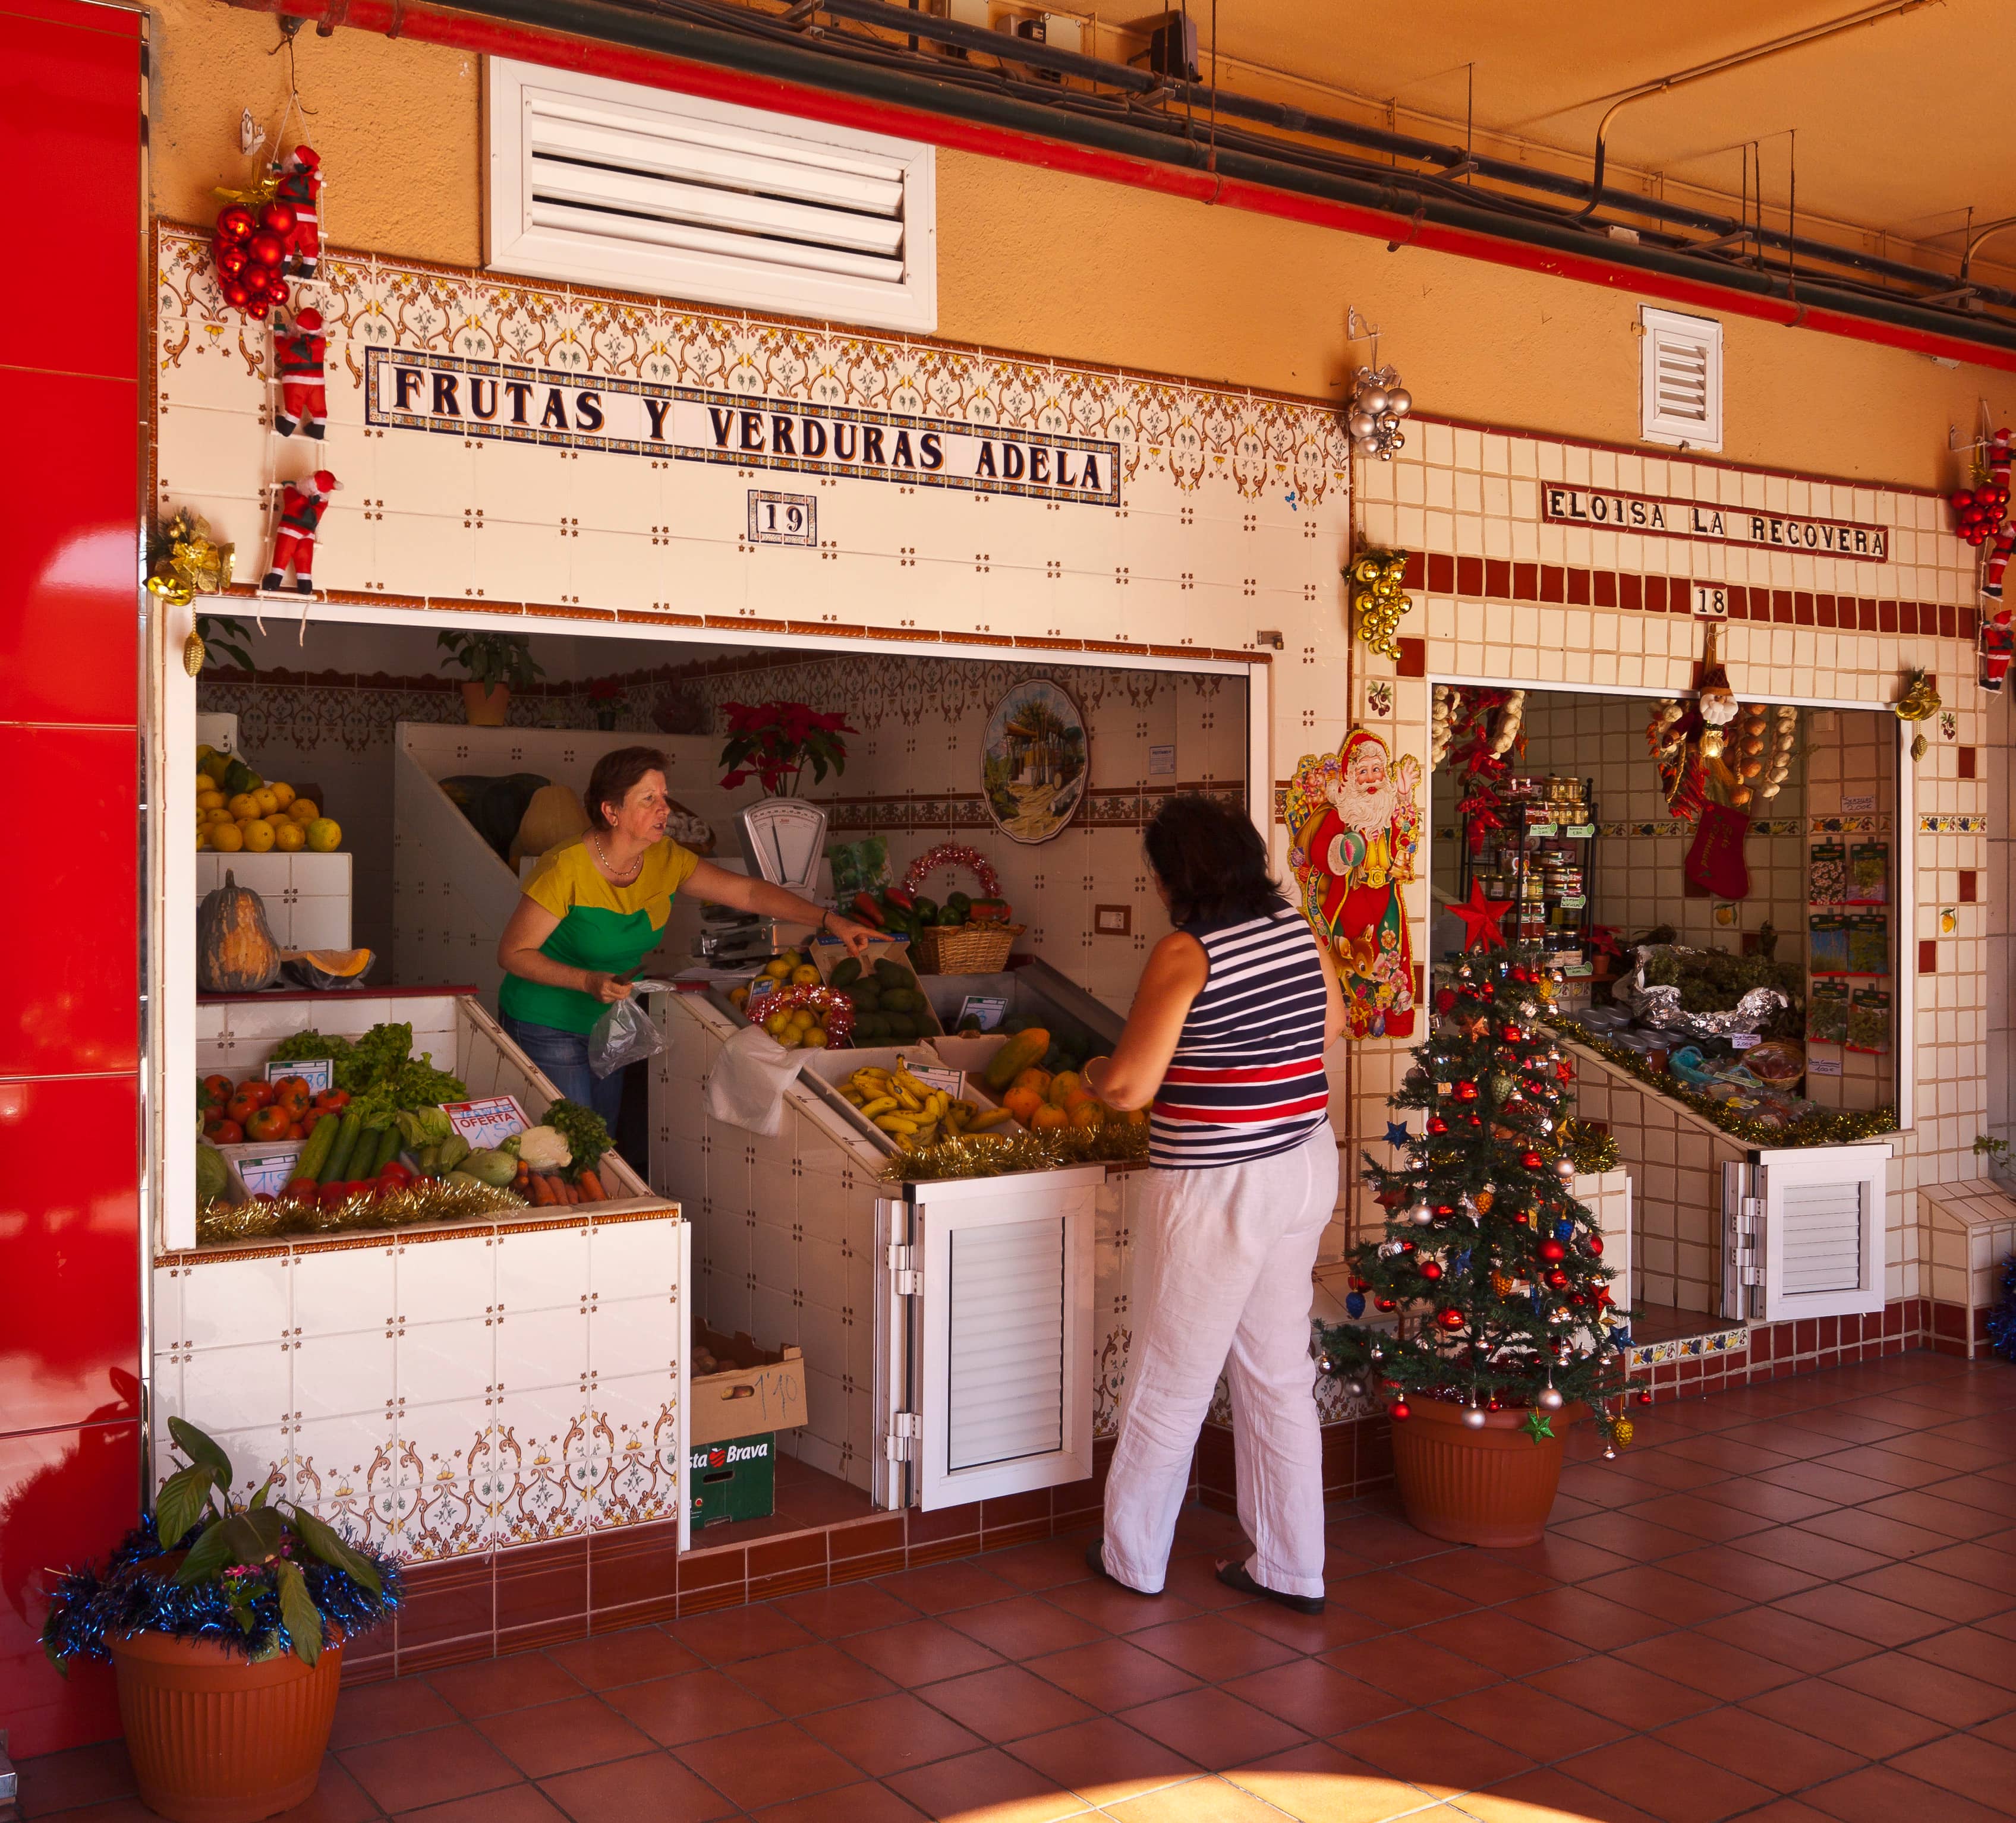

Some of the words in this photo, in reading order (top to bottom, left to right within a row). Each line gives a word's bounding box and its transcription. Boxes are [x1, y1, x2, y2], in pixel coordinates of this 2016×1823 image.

[393, 367, 605, 433] FRUTAS
[642, 399, 671, 441] Y
[706, 406, 944, 472] VERDURAS
[975, 441, 1102, 491] ADELA
[765, 503, 803, 533] 19
[1549, 489, 1665, 528] ELOISA
[1691, 507, 1725, 535] LA
[1751, 516, 1885, 556] RECOVERA
[1698, 588, 1725, 614] 18
[459, 1113, 515, 1128] OFERTA
[726, 1443, 768, 1463] Brava
